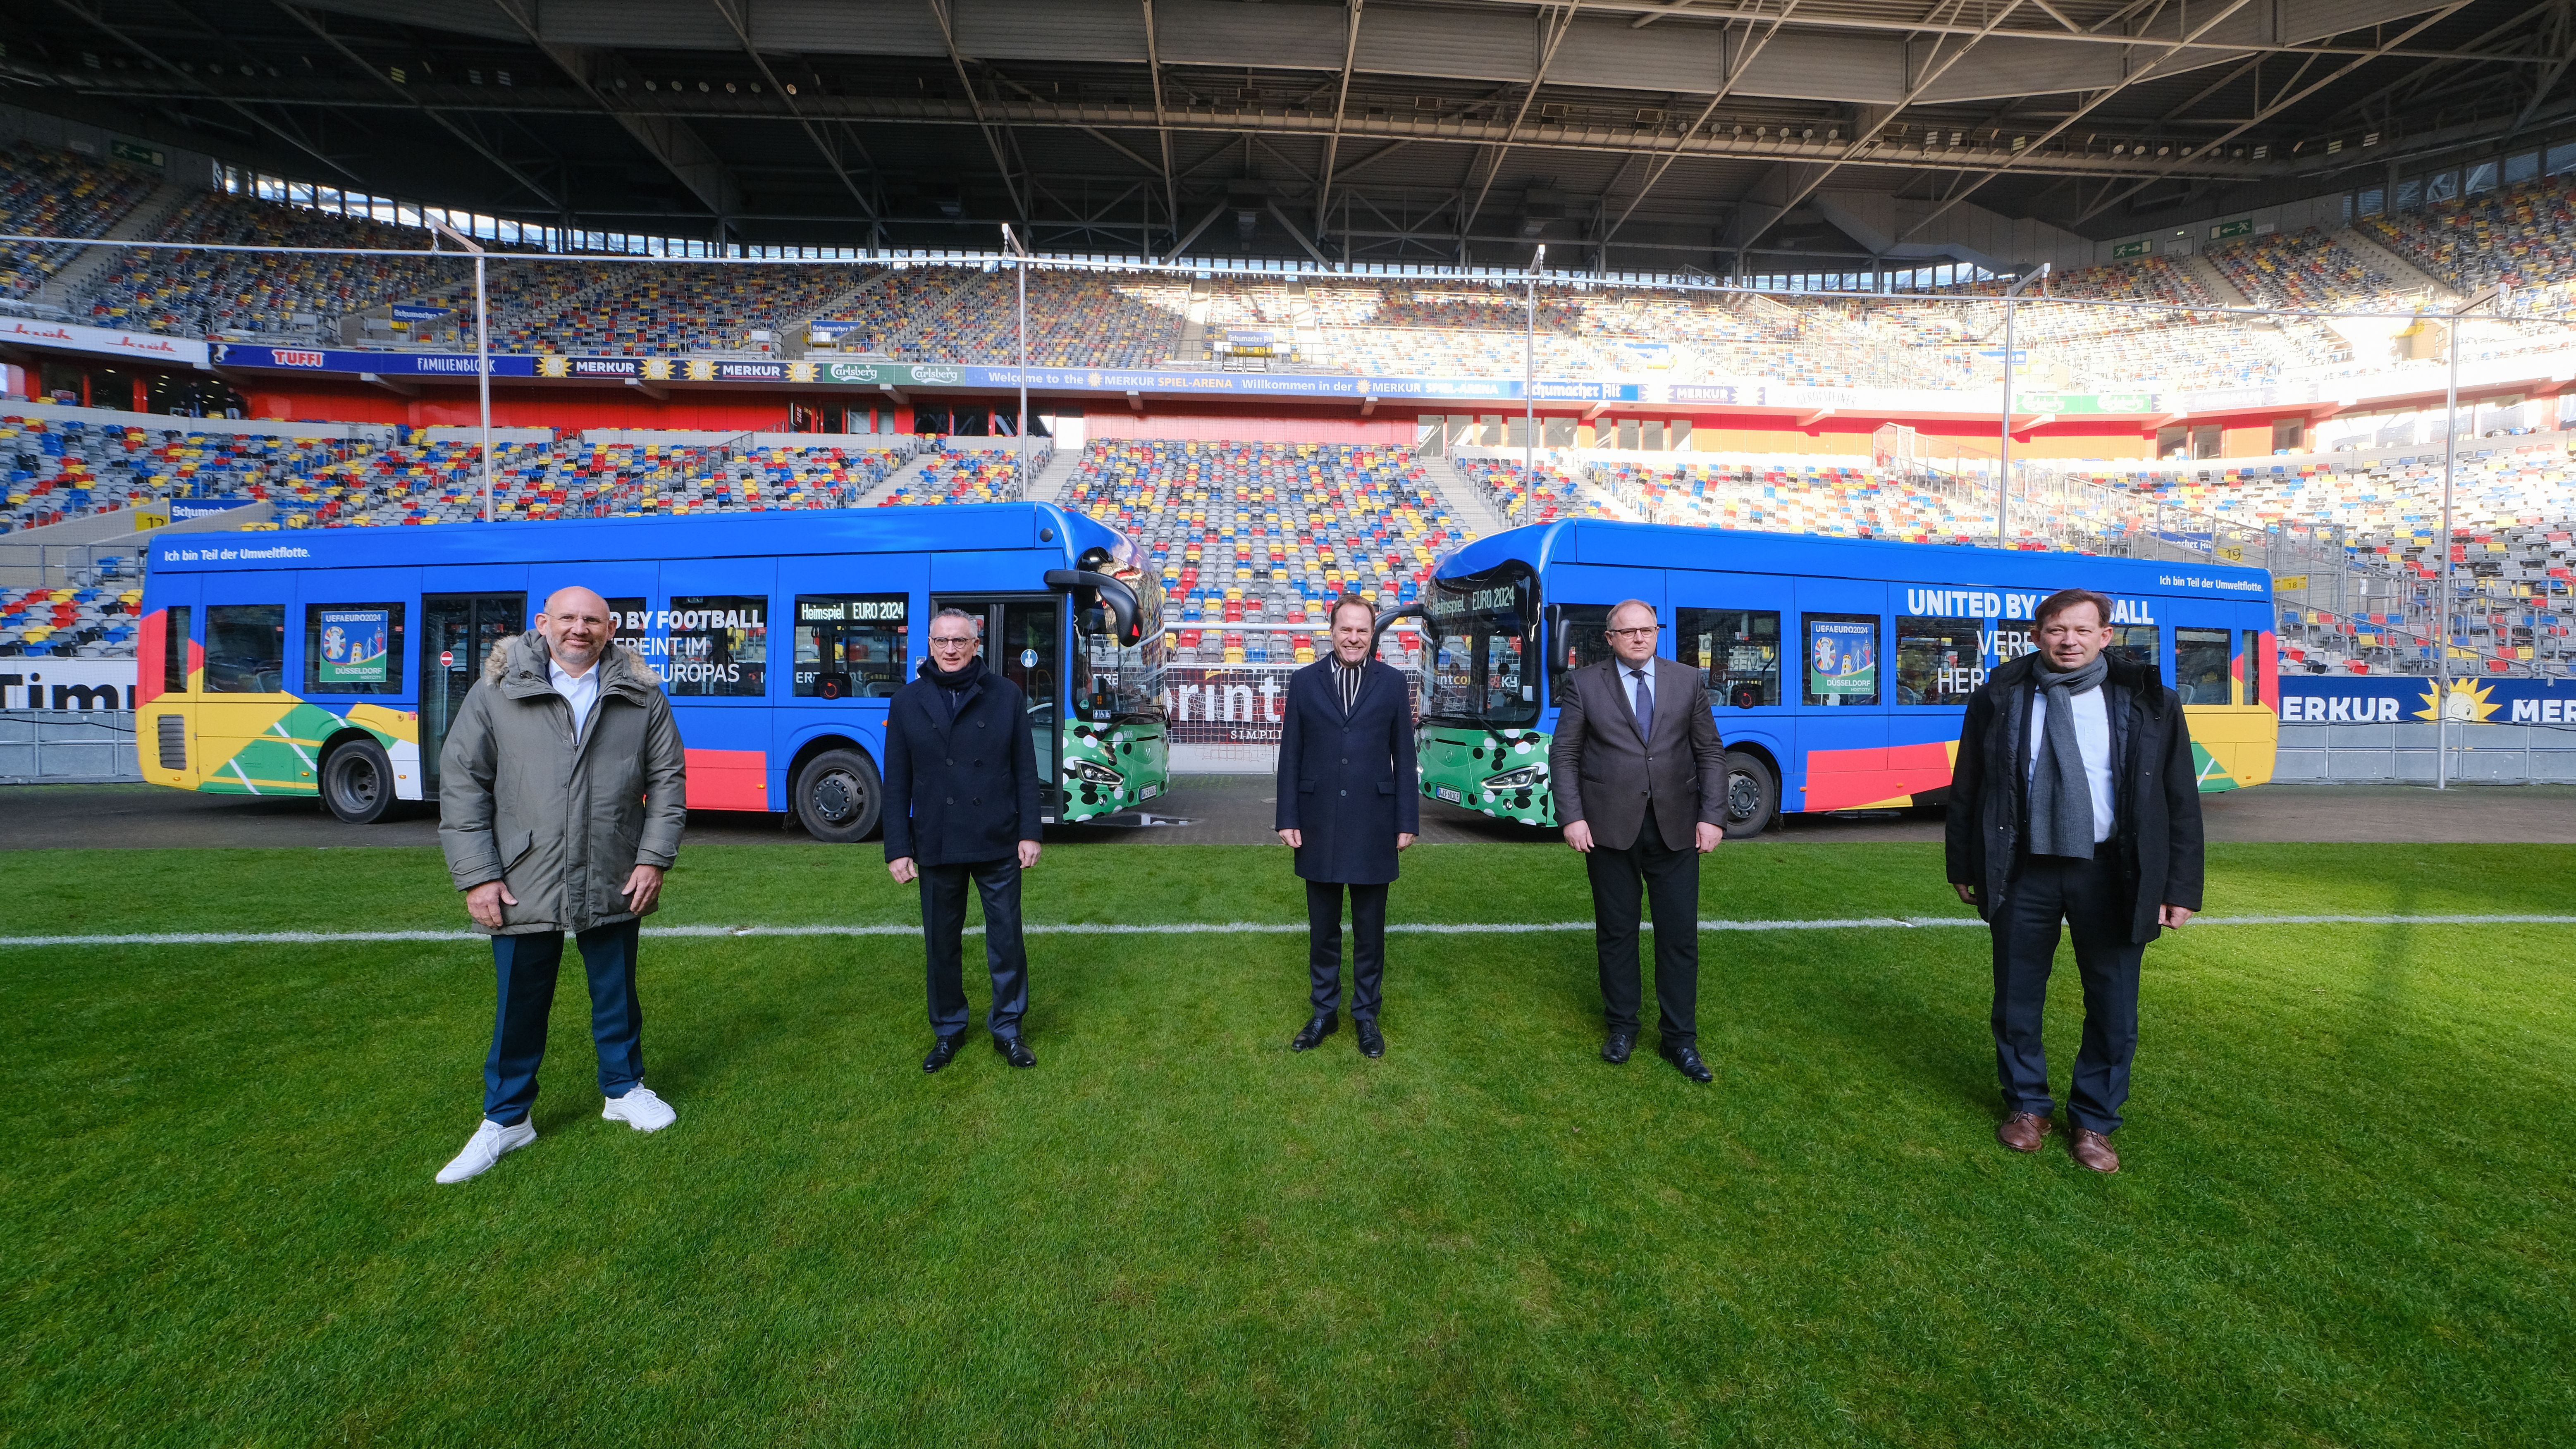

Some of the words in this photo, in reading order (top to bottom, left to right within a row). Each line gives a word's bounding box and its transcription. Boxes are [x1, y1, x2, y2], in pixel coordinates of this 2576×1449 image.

[273, 351, 324, 367] TUFFI
[417, 357, 496, 372] FAMILIENBLOK
[577, 361, 635, 372] MERKUR
[723, 365, 780, 376] MERKUR
[831, 364, 878, 379] Carlsberg
[911, 366, 957, 381] Carlsberg
[1046, 373, 1059, 384] to
[1065, 374, 1084, 384] the
[1105, 375, 1154, 386] MERKUR
[1158, 377, 1232, 388] SPIEL-ARENA
[1242, 380, 1316, 391] Willkommen
[1319, 382, 1330, 391] in
[1334, 382, 1352, 391] der
[1373, 382, 1421, 393] MERKUR
[1425, 384, 1499, 395] SPIEL-ARENA
[1602, 384, 1621, 399] Alt
[1676, 389, 1728, 399] MERKUR
[165, 550, 179, 561] Ich
[182, 550, 198, 561] bin
[201, 549, 218, 560] Teil
[220, 549, 238, 560] der
[240, 547, 311, 559] Umweltflotte.
[2226, 548, 2241, 561] 19
[2159, 575, 2171, 585] Ich
[2173, 576, 2184, 586] bin
[2187, 577, 2199, 587] Teil
[2201, 578, 2213, 588] der
[2216, 580, 2264, 592] Umweltflotte.
[1432, 594, 1466, 617] Heimspiel
[1472, 589, 1492, 611] EURO
[1494, 585, 1515, 608] 2024
[1908, 589, 2001, 618] UNITED
[2006, 593, 2036, 619] BY
[626, 611, 653, 629] BY
[657, 609, 764, 629] FOOTBALL
[801, 603, 845, 621] Heimspiel
[853, 602, 878, 619] EURO
[880, 602, 904, 619] 2024
[685, 637, 707, 656] IM
[335, 666, 382, 675] DÜSSELDORF
[1826, 678, 1871, 687] DÜSSELDORF
[1938, 667, 1991, 693] HER
